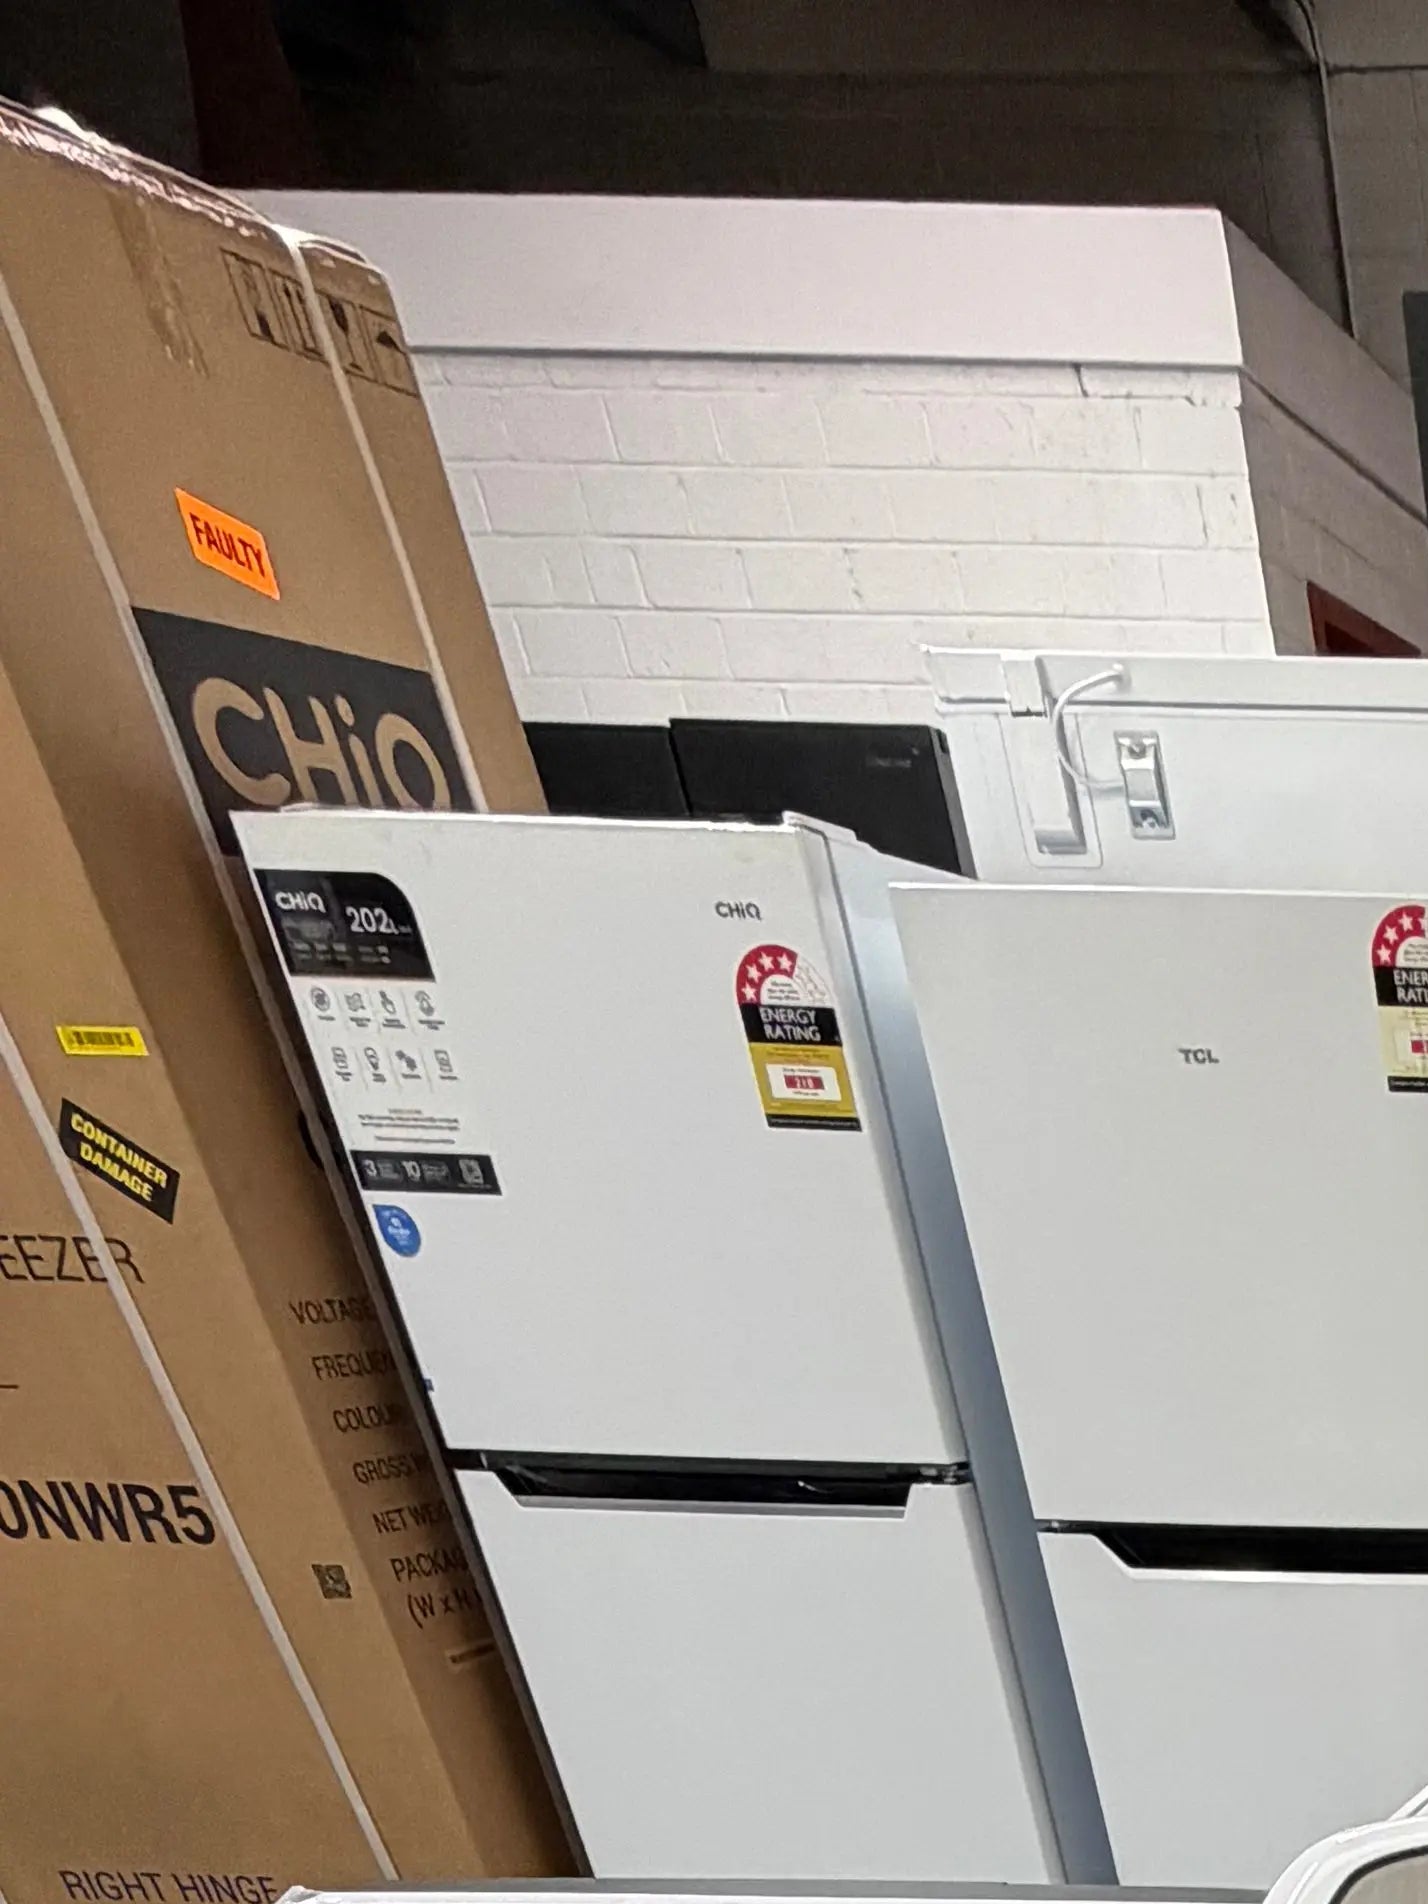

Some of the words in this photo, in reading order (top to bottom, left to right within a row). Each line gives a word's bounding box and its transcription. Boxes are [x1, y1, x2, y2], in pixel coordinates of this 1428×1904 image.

[189, 511, 267, 578] FAULTY
[760, 1007, 817, 1024] ENERGY
[765, 1025, 822, 1043] RATING
[1178, 1047, 1220, 1065] TCL
[71, 1112, 168, 1189] CONTAINER
[80, 1142, 154, 1202] DAMAGE
[373, 1506, 408, 1534] NET
[60, 1870, 163, 1902] RIGHT
[176, 1874, 278, 1904] HINGE
